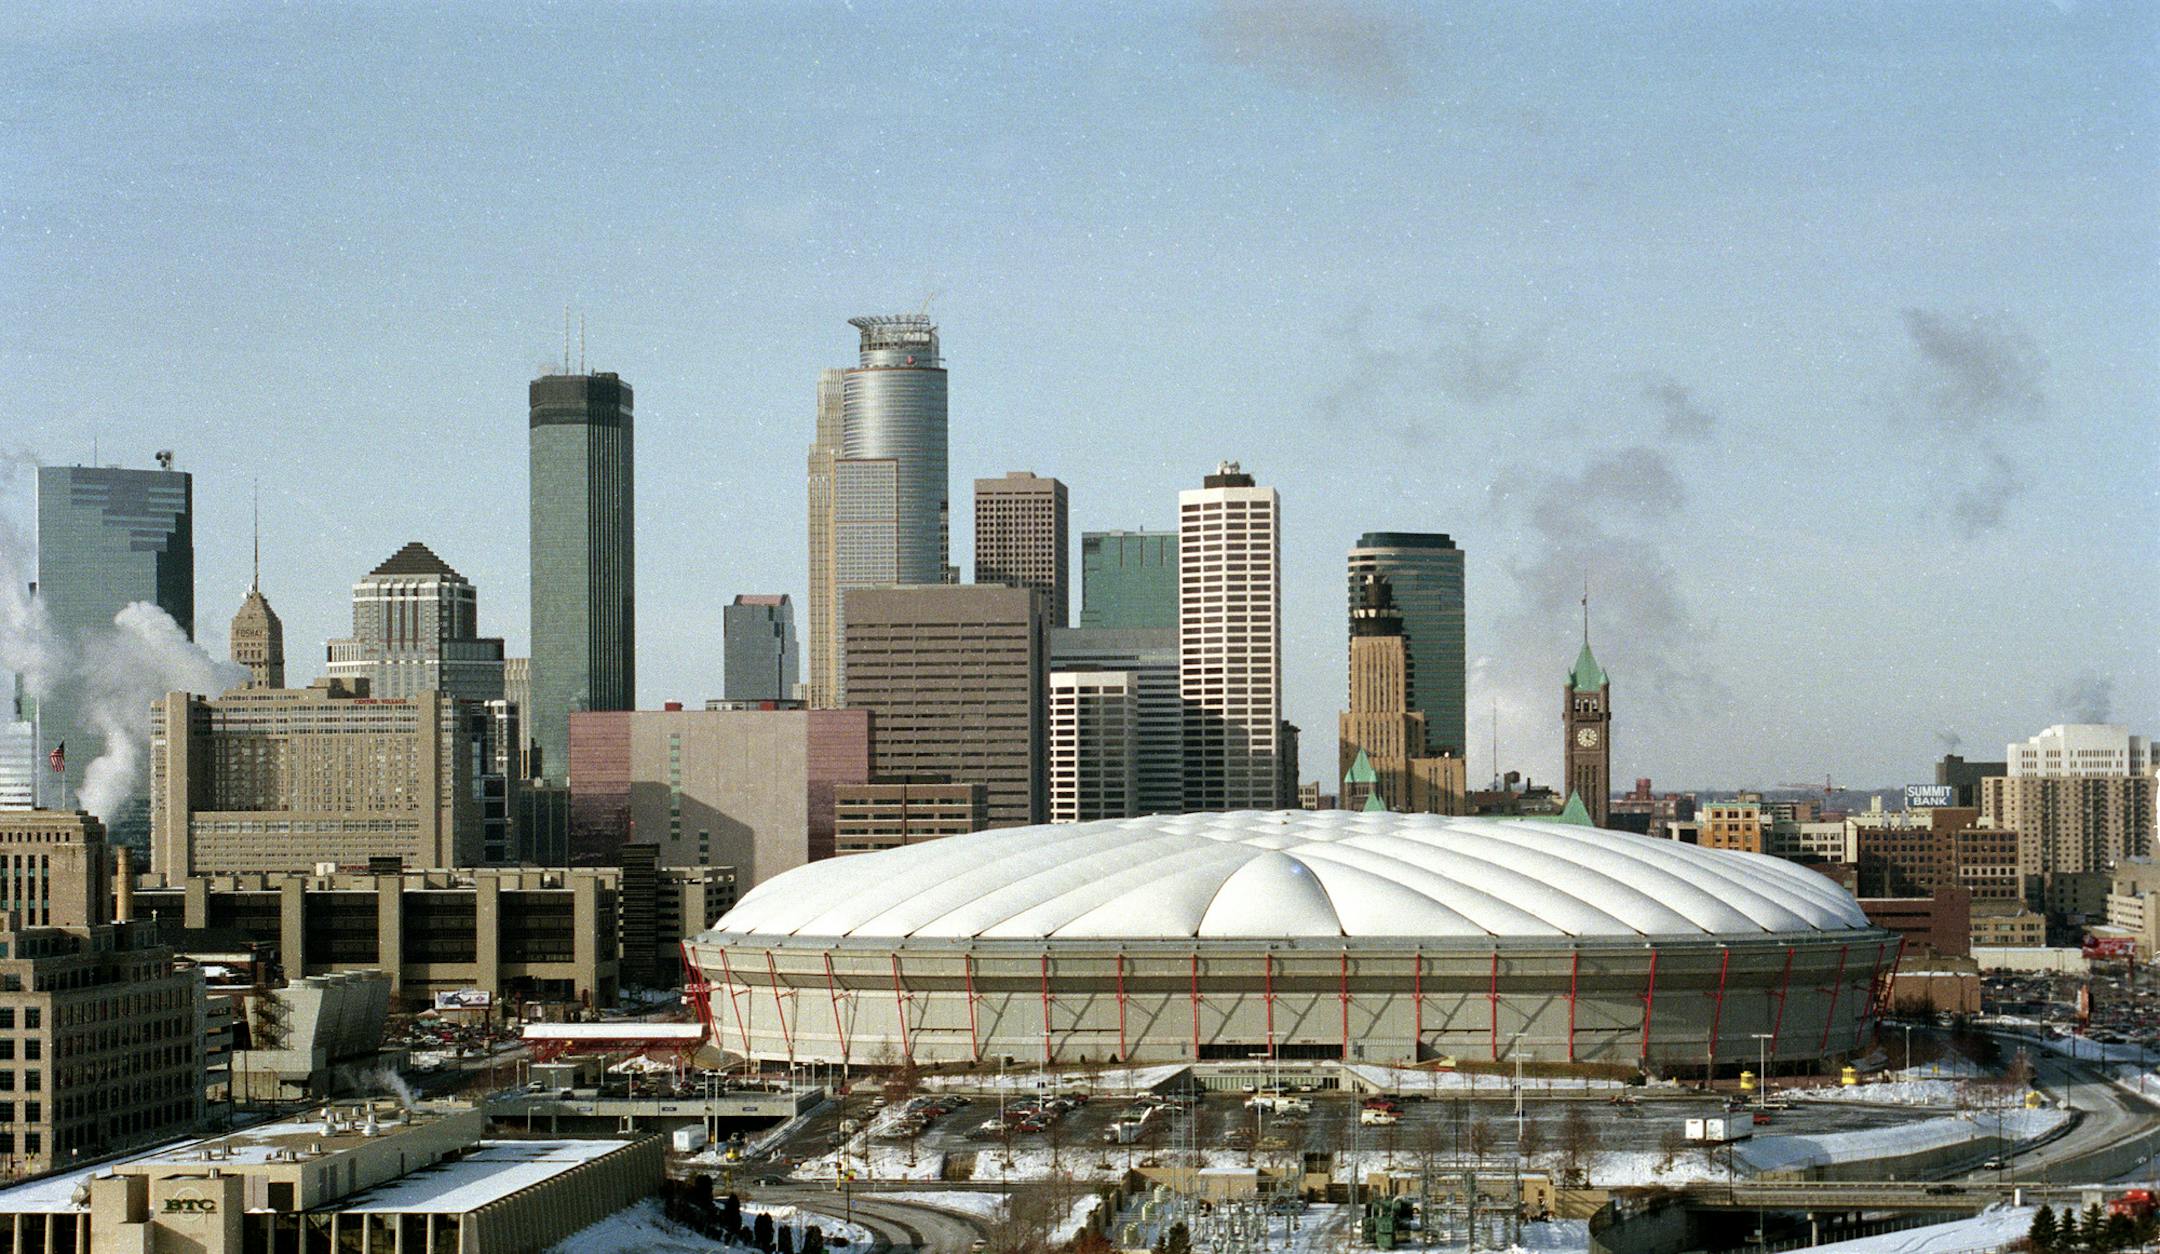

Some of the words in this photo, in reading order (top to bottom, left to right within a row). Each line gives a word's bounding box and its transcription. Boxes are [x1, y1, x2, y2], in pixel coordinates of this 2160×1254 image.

[1907, 785, 1952, 797] SUMMIT
[1913, 796, 1948, 806] BANK
[163, 1198, 217, 1211] BTC
